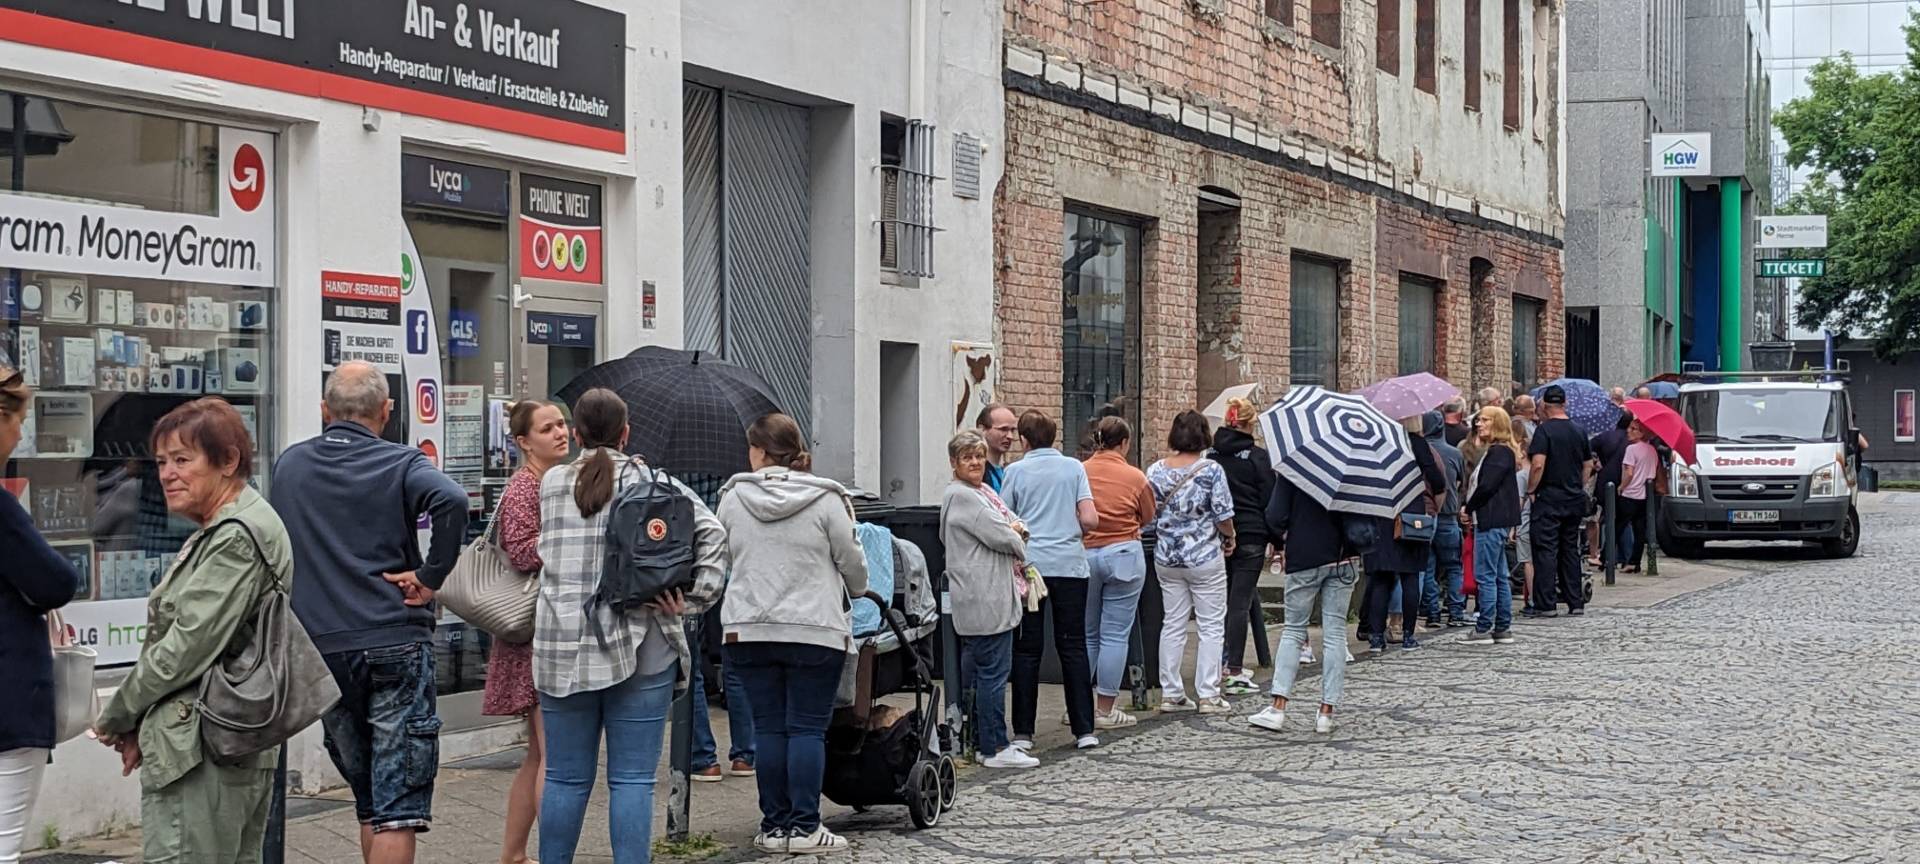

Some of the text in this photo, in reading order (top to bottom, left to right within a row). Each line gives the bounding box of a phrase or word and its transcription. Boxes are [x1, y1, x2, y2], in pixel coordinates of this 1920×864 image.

[404, 0, 560, 69] An- & Verkauf
[339, 41, 443, 82] Handy-Reparatur
[453, 66, 498, 94] Verkauf
[504, 78, 558, 108] Ersatzteile
[559, 90, 567, 109] &
[568, 92, 609, 118] Zubehör
[1663, 152, 1699, 166] HGW
[430, 164, 463, 193] Lyca
[529, 187, 591, 219] PHONE WELT
[78, 215, 257, 275] MoneyGram
[1763, 262, 1816, 275] TICKET
[325, 280, 399, 298] HANDY-REPARATUR
[451, 320, 473, 339] GLS
[530, 319, 548, 336] Lyca
[80, 627, 98, 646] LG
